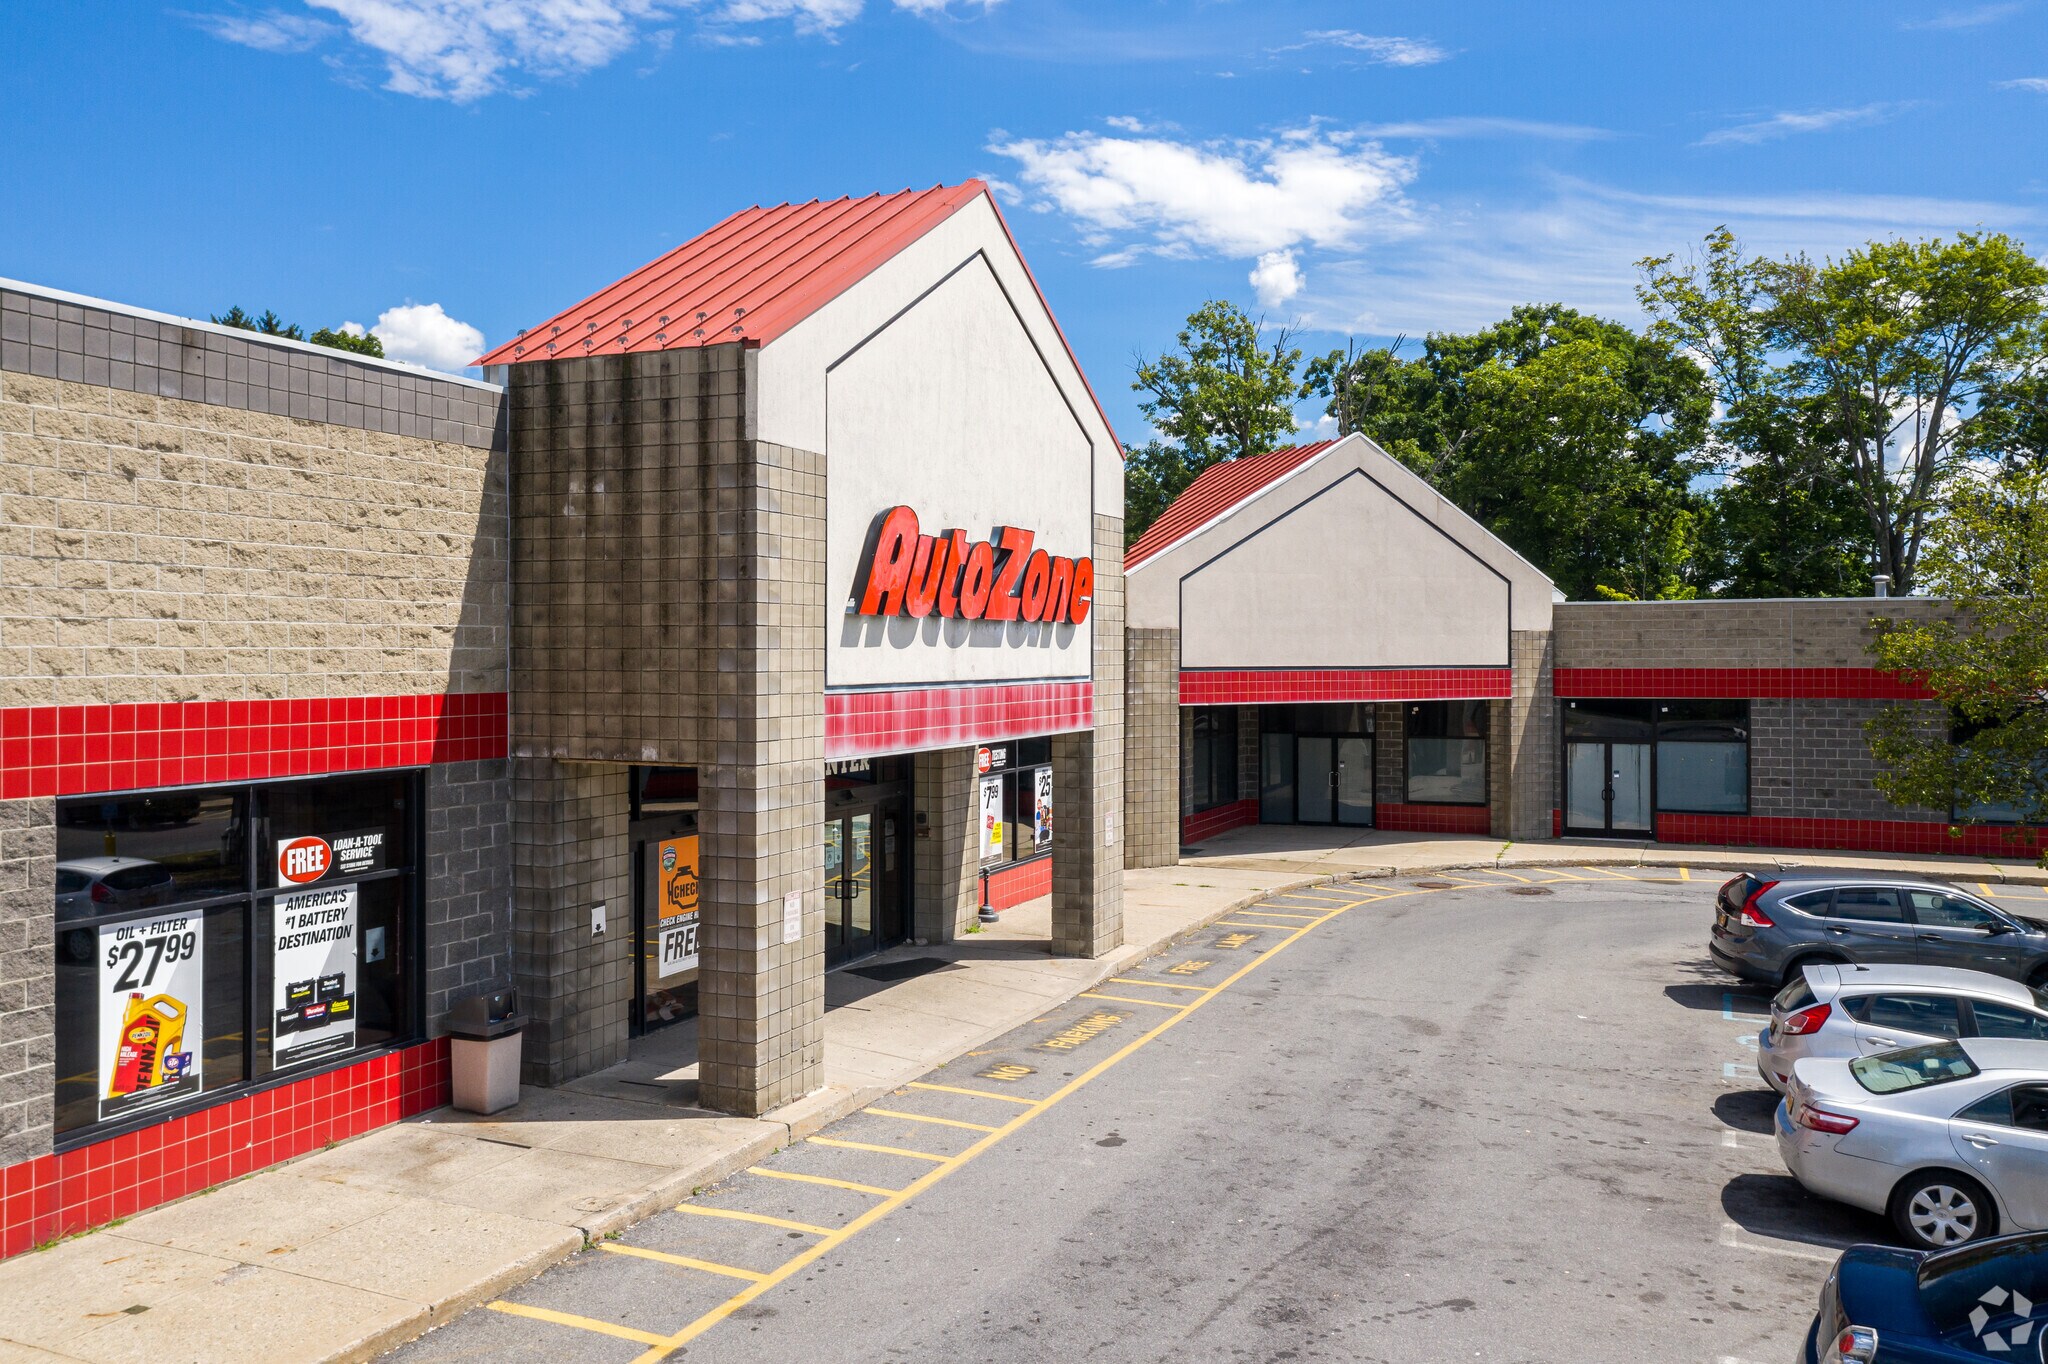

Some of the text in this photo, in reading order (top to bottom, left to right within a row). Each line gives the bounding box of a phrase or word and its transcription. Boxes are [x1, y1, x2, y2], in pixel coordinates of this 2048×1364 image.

[848, 505, 1094, 625] AutoZone
[333, 833, 383, 852] LOAN-A-TOOL
[340, 846, 374, 862] SERVICE
[286, 845, 325, 876] FREE
[285, 889, 348, 912] AMERICA'S
[116, 926, 135, 941] OIL
[150, 917, 188, 935] FILTER
[285, 906, 349, 930] #1 BATTERY
[660, 915, 676, 928] CHECK
[278, 924, 352, 951] DESTINATION
[106, 931, 196, 994] $2799
[1045, 1013, 1123, 1049] PARKING
[985, 1064, 1033, 1081] NO
